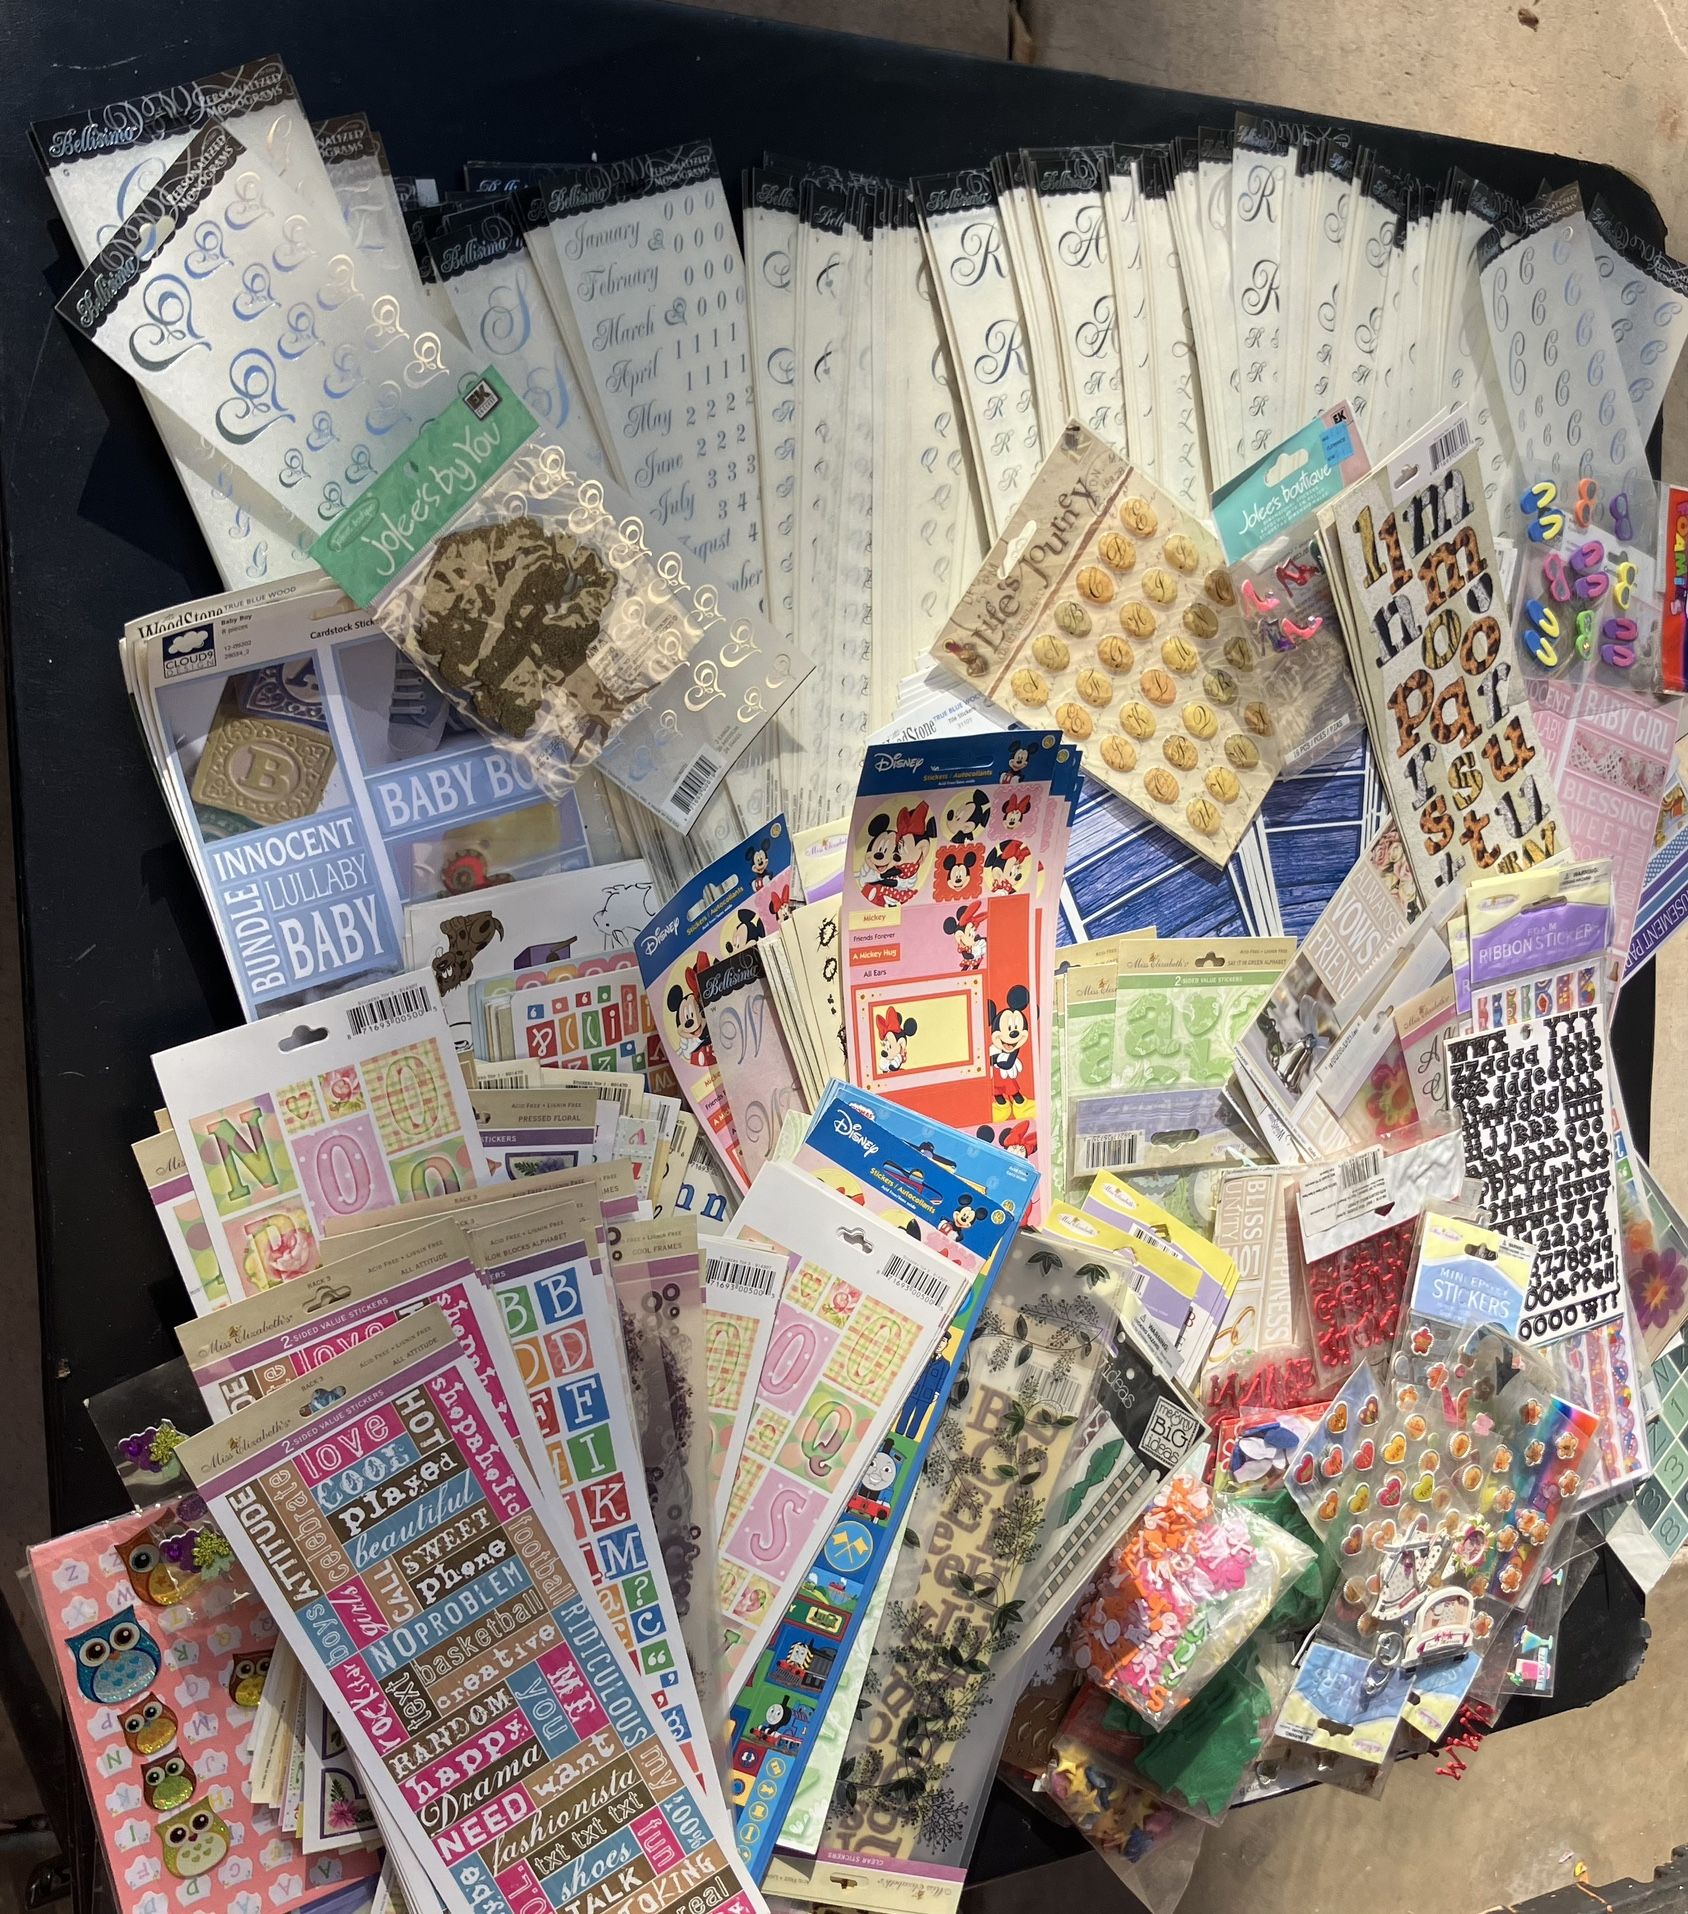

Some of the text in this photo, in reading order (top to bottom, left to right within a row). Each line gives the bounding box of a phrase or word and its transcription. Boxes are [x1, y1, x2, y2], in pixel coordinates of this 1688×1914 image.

[564, 219, 639, 260] January
[577, 262, 659, 302] February
[592, 305, 654, 352] March
[606, 349, 659, 397] April
[623, 404, 672, 439] May
[1333, 410, 1346, 424] EK
[429, 459, 477, 492] by
[453, 422, 500, 463] You
[634, 448, 683, 488] June
[649, 485, 695, 525] July
[1238, 497, 1281, 535] Jolee's
[1281, 464, 1331, 503] boutique
[223, 586, 297, 611] TRUE BLUE WOOD
[165, 651, 213, 670] CLOUD9
[310, 623, 353, 640] Cardstock
[166, 659, 215, 677] DESIGN
[1582, 689, 1670, 754] BABY GIRL
[378, 748, 540, 828] BABY BO
[212, 816, 355, 883] INNOCENT
[264, 853, 368, 910] LULLABY
[1354, 868, 1398, 931] ALWAYS
[227, 882, 286, 994] BUNDLE
[280, 894, 384, 979] BABY
[853, 934, 873, 942] Friends
[864, 914, 886, 922] Mickey
[1332, 886, 1382, 964] VOWS
[860, 951, 882, 959] Mickey
[884, 949, 896, 957] Hug
[1308, 923, 1360, 1000] FRIEN
[1479, 938, 1532, 964] RIBBON
[870, 1167, 894, 1187] Stickers
[898, 1186, 935, 1213] Autocollants
[1222, 1181, 1243, 1241] UNITY
[1244, 1180, 1266, 1240] BLISS
[401, 1252, 449, 1276] ALL ATTITUDE
[503, 1232, 567, 1256] BLOCKS ALPHABET
[319, 1312, 347, 1329] VALUE
[348, 1297, 389, 1318] STICKERS
[1432, 1279, 1511, 1318] STICKERS
[198, 1337, 232, 1359] Miss
[406, 1337, 439, 1360] ATTITUDE
[319, 1413, 345, 1432] VALUE
[346, 1389, 385, 1412] STICKERS
[1102, 1362, 1135, 1409] ideas
[299, 1414, 389, 1480] love
[396, 1389, 448, 1448] HOT
[200, 1450, 232, 1472] Miss
[1145, 1434, 1179, 1464] ideas
[229, 1485, 320, 1602] ATTITUDE
[269, 1469, 350, 1583] celebrate
[355, 1469, 474, 1569] beautiful
[401, 1506, 491, 1576] SWEET
[417, 1538, 507, 1605] phone
[509, 1518, 576, 1605] football
[329, 1585, 391, 1637] girls
[370, 1562, 525, 1674] NO PROBLEM
[374, 1558, 415, 1626] CALL
[306, 1603, 350, 1667] boys
[415, 1589, 543, 1686] basketball
[436, 1624, 556, 1710] creative
[547, 1661, 596, 1723] ME
[561, 1601, 647, 1749] RIDICULOUS
[385, 1672, 432, 1731] text
[515, 1677, 568, 1741] you
[388, 1687, 514, 1778] RANDOM
[406, 1718, 529, 1803] happy
[420, 1743, 542, 1832] Drama
[532, 1731, 616, 1797] want
[639, 1747, 678, 1791] my
[436, 1793, 536, 1862] NEED
[492, 1766, 638, 1874] fashionista
[533, 1792, 644, 1874] txt txt txt
[636, 1818, 675, 1867] fun
[664, 1793, 707, 1849] 100%
[560, 1842, 632, 1902] shoes
[827, 1852, 860, 1863] STICKERS
